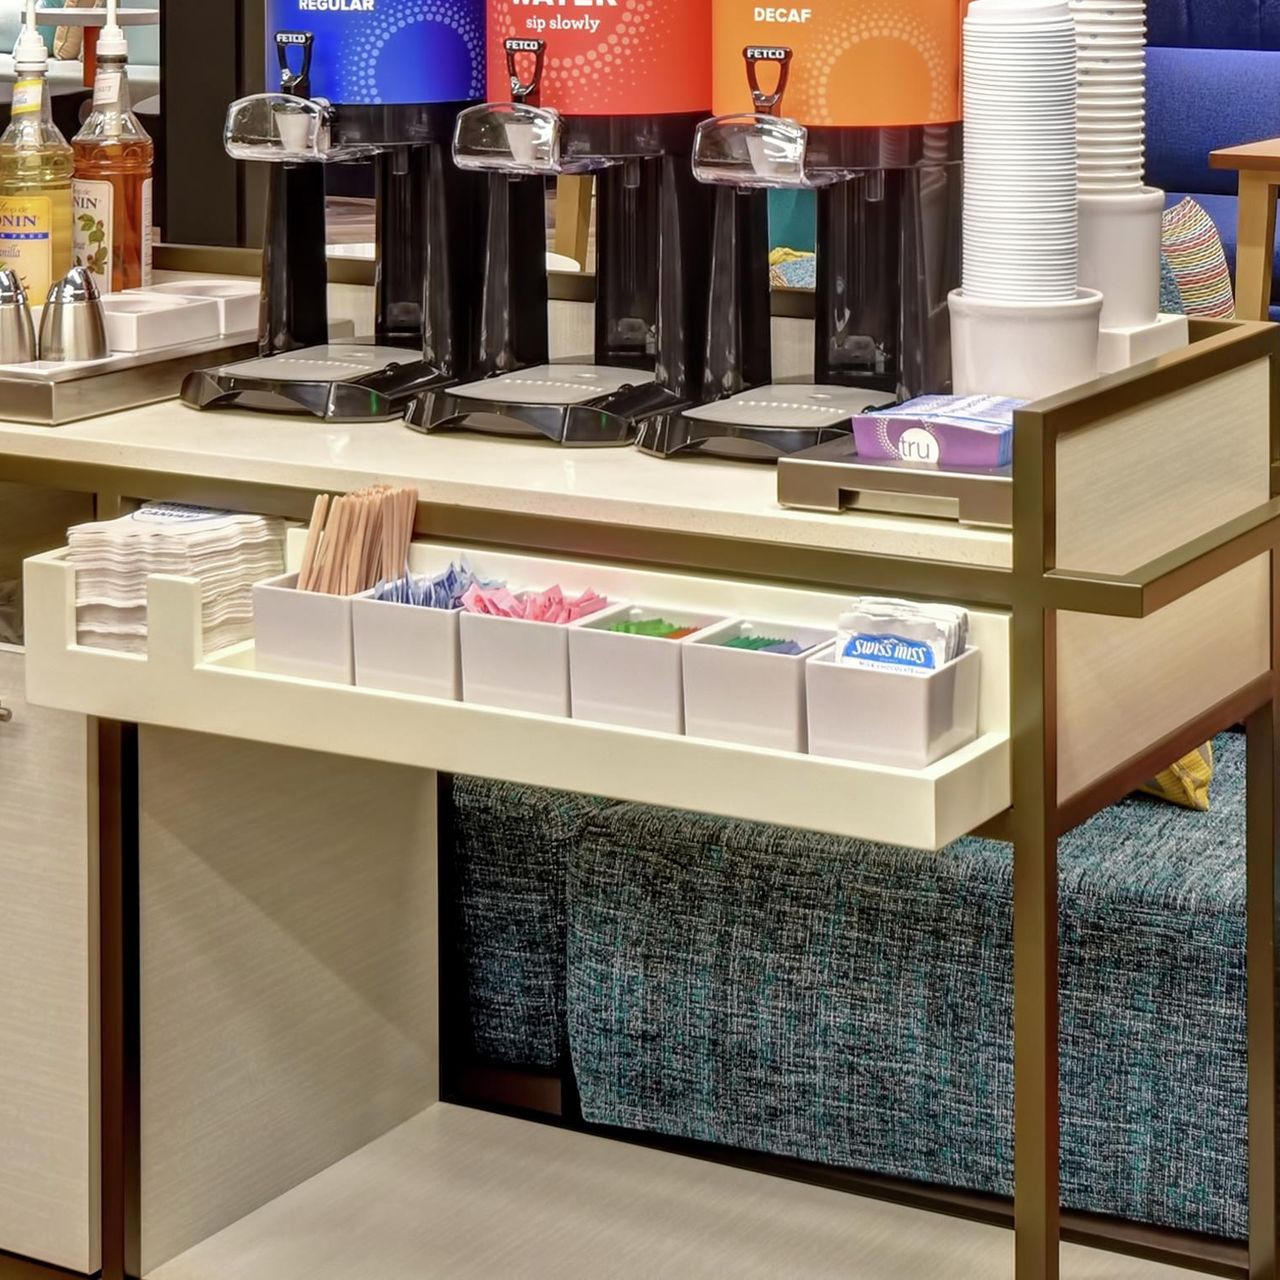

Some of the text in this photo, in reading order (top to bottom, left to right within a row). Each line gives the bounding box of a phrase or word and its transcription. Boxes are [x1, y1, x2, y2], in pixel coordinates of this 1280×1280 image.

[753, 7, 812, 23] DECAF
[526, 14, 601, 33] sip slowly
[276, 33, 306, 43] FETCO
[505, 40, 538, 50] FETCO
[747, 49, 785, 59] FETCO
[901, 436, 929, 459] tru
[852, 639, 892, 658] SWISS
